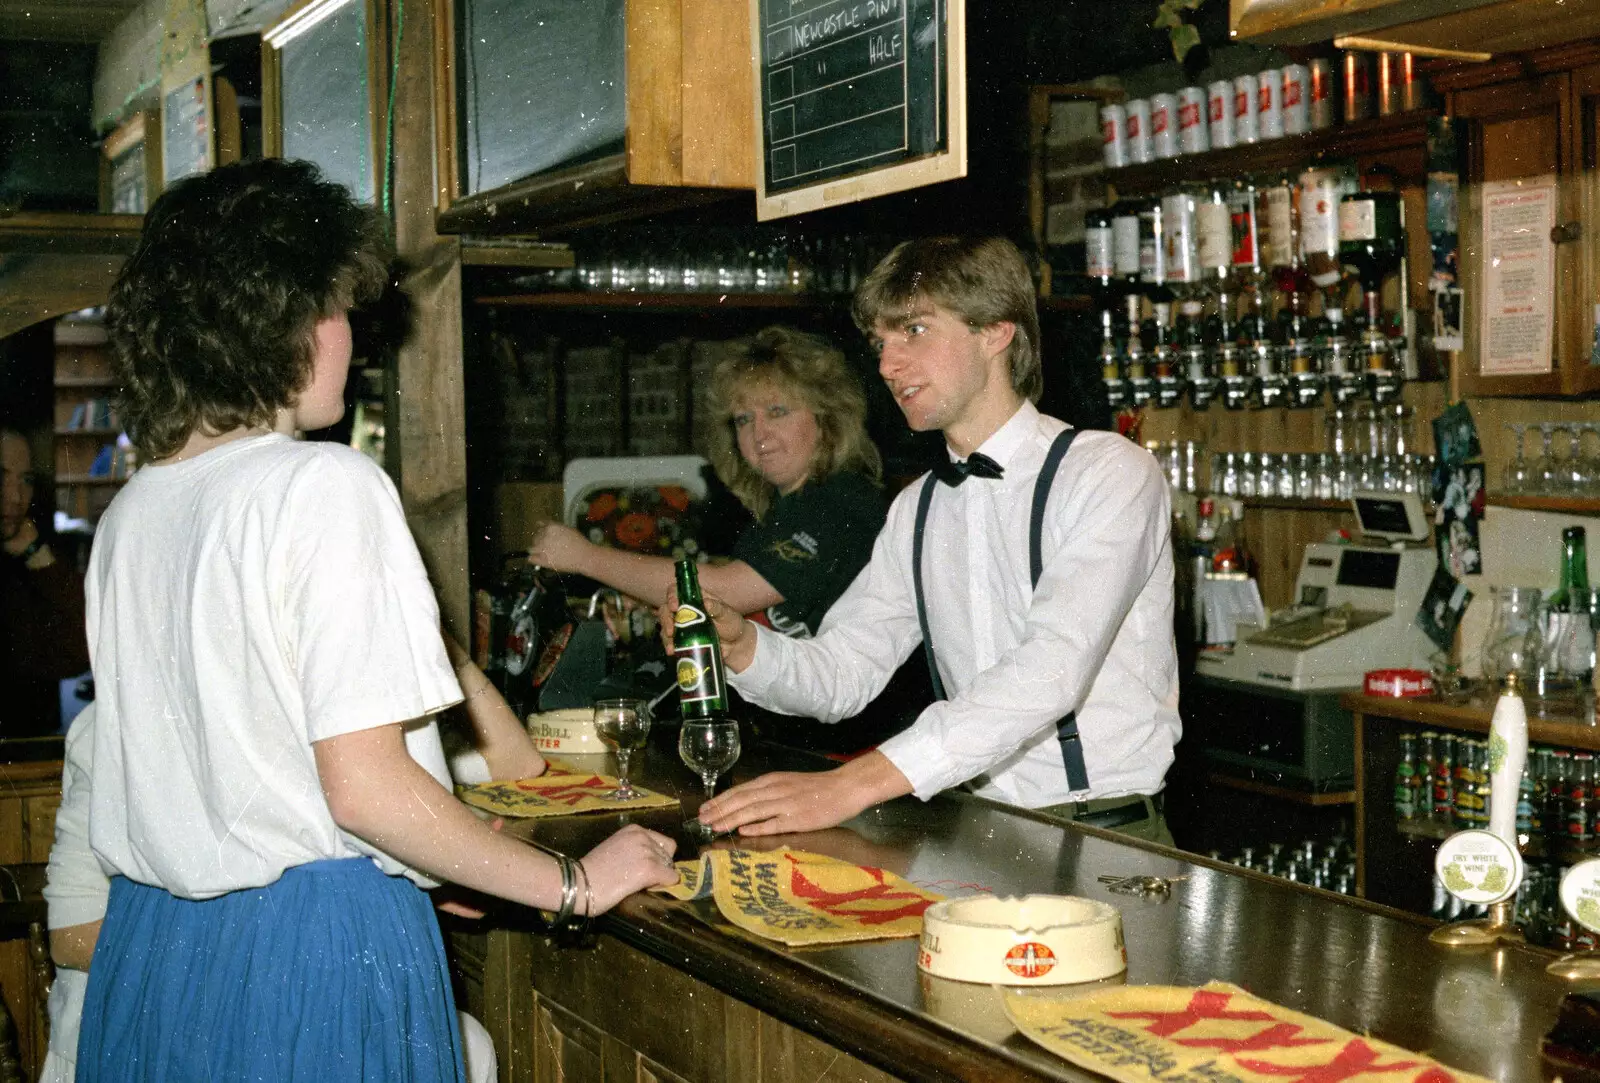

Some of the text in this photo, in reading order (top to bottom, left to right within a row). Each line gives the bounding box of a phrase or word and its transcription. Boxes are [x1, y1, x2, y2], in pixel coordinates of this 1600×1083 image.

[795, 5, 860, 48] NEWCASTLE
[869, 34, 902, 66] HALF
[534, 737, 561, 750] TTER
[1452, 854, 1499, 863] DRY WHITE
[1464, 864, 1485, 873] WINE
